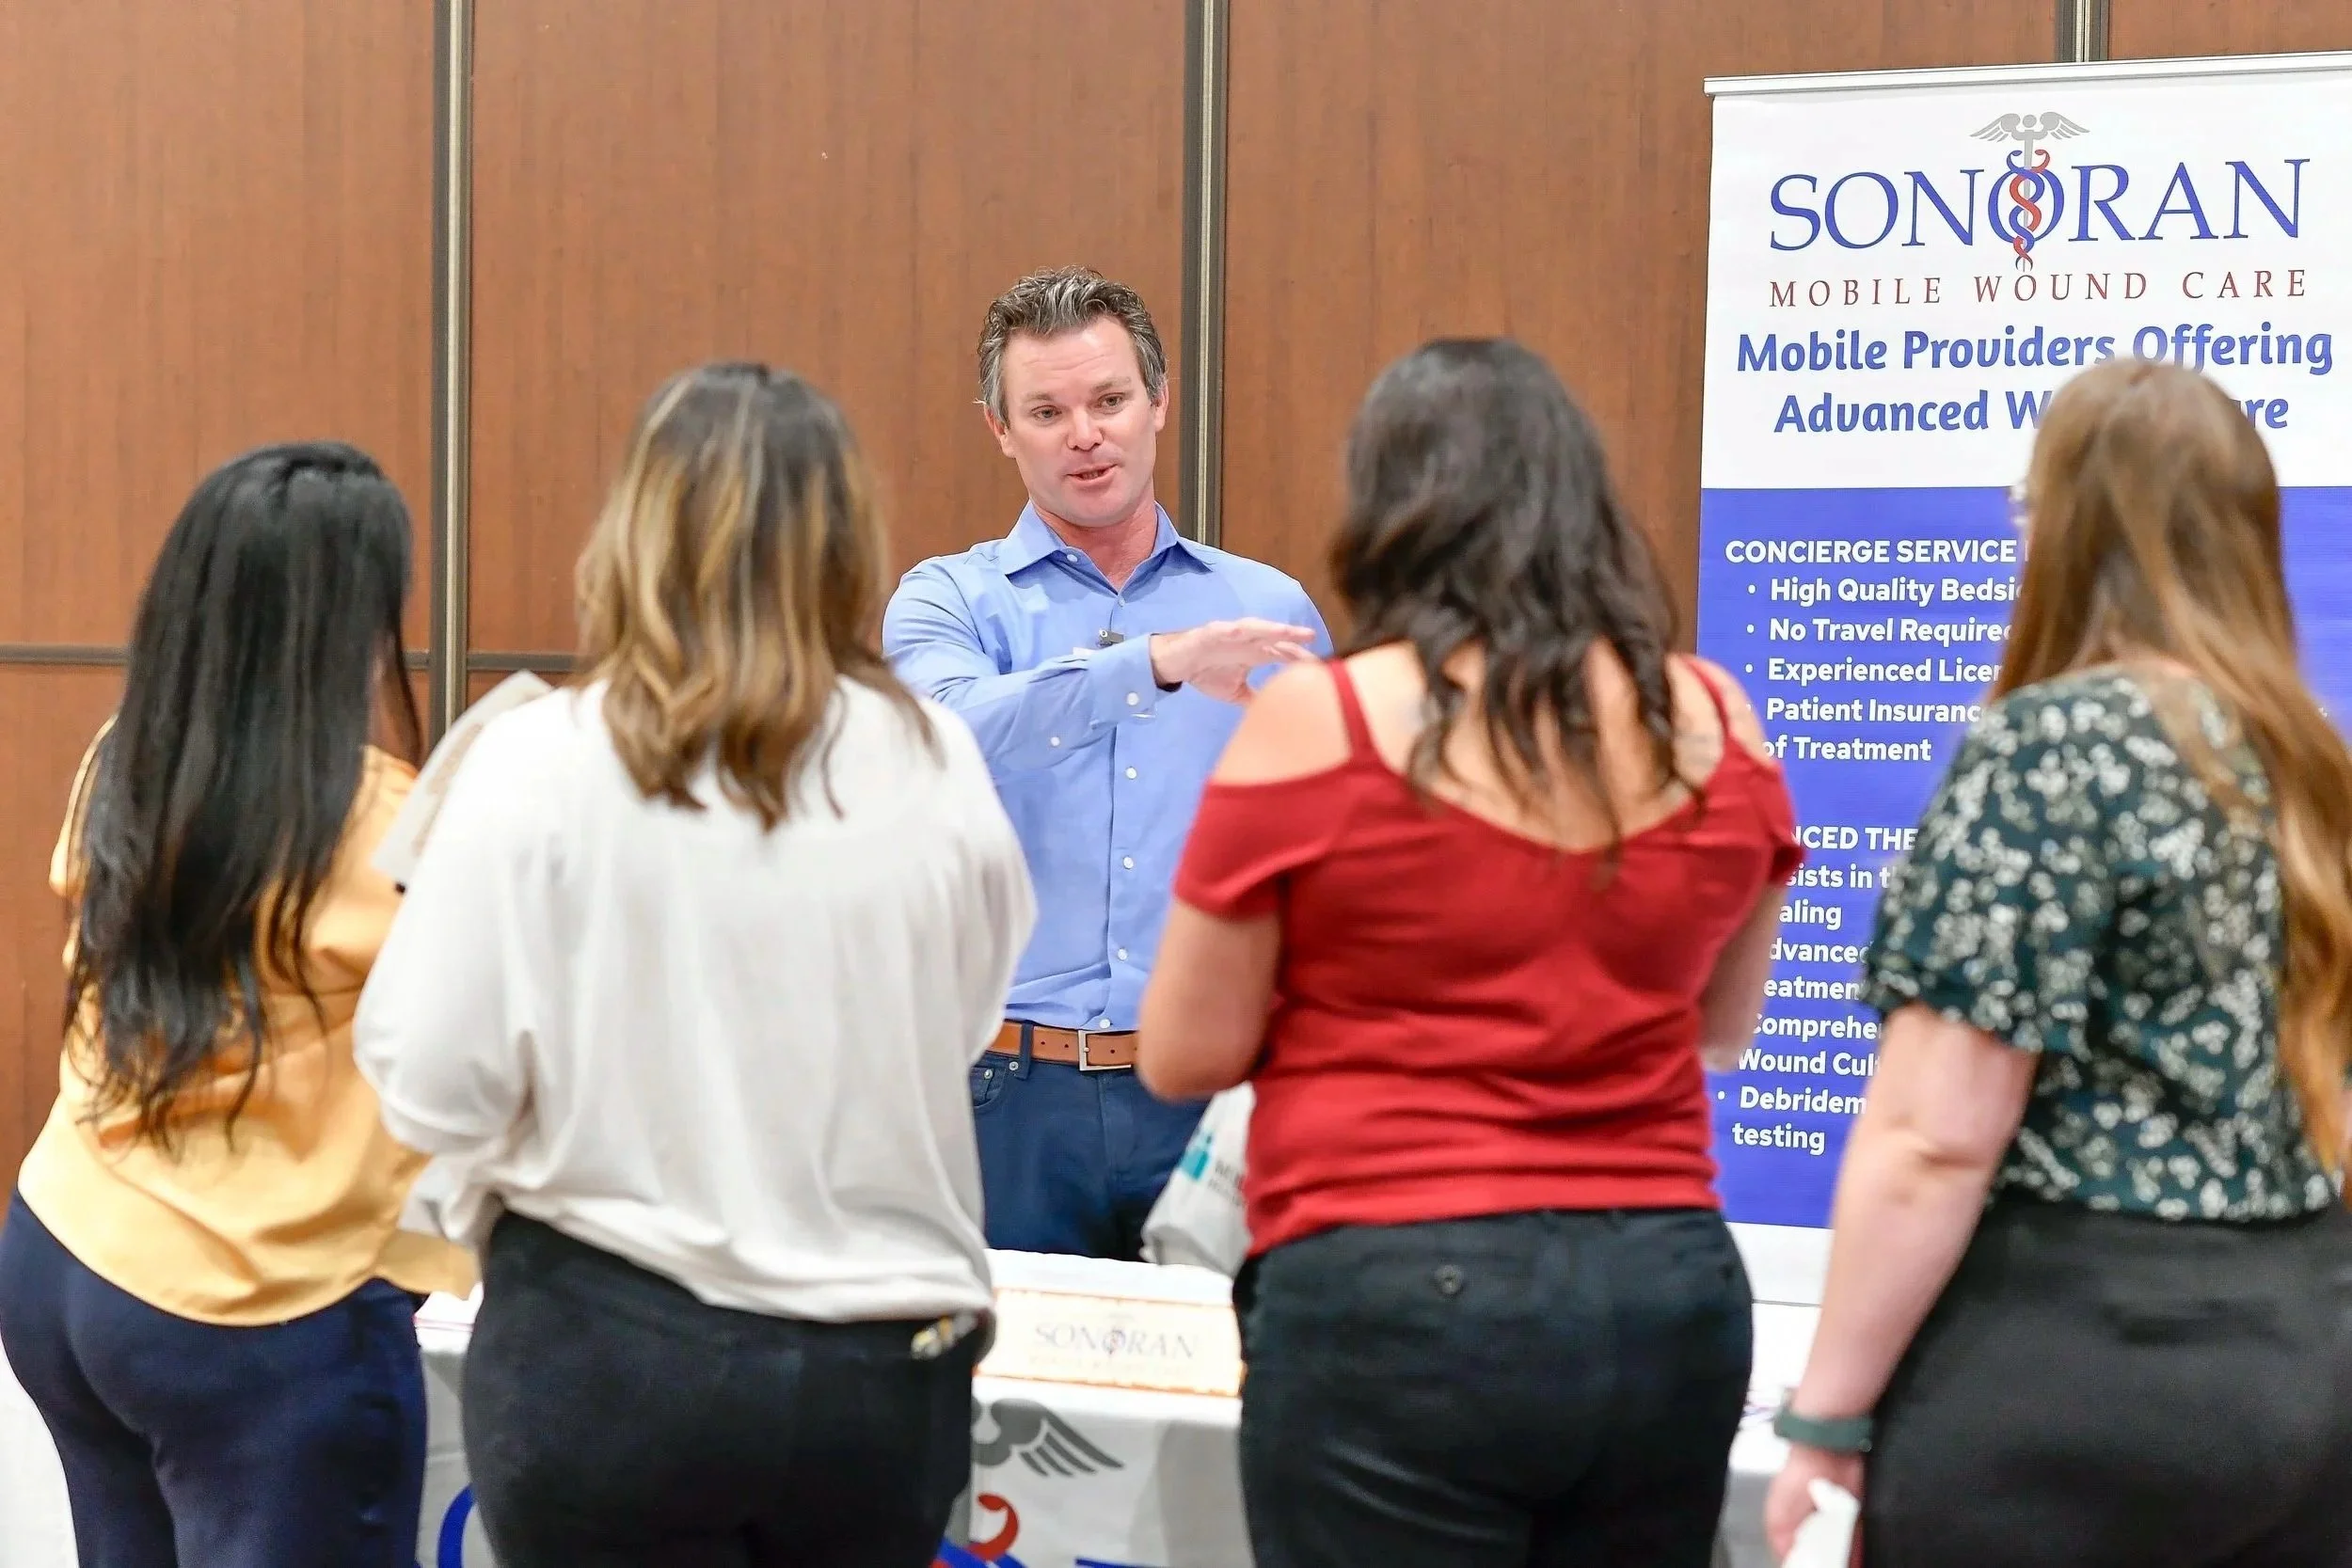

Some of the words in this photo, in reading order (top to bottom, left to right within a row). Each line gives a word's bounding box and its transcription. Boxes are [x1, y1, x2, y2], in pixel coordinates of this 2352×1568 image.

[1769, 157, 2310, 251] SONORAN
[1768, 277, 1943, 308] MOBILE
[1974, 271, 2148, 304] WOUND
[2182, 268, 2308, 300] CARE
[1737, 328, 1887, 373] Mobile
[1902, 325, 2116, 369] Providers
[2132, 321, 2333, 376] Offering
[1773, 388, 1989, 434] Advanced
[1725, 539, 1890, 563] CONCIERGE
[1895, 539, 2017, 563] SERVICE
[1771, 577, 1832, 608] High
[1837, 577, 1935, 608] Quality
[1770, 618, 1806, 641] No
[1812, 617, 1894, 641] Travel
[1768, 657, 1931, 687] Experienced
[1766, 695, 1864, 721] Patient
[1869, 697, 1982, 722] Insuranc
[1762, 734, 1788, 759] of
[1792, 736, 1932, 762] Treatment
[1864, 826, 1919, 851] THE
[1849, 863, 1873, 889] in
[1778, 897, 1842, 931] aling
[1769, 937, 1872, 963] dvance
[1763, 975, 1862, 1001] eatmen
[1739, 1048, 1827, 1075] Wound
[1832, 1052, 1880, 1077] Cul
[1740, 1085, 1867, 1116] Debridem
[1732, 1121, 1826, 1156] testing
